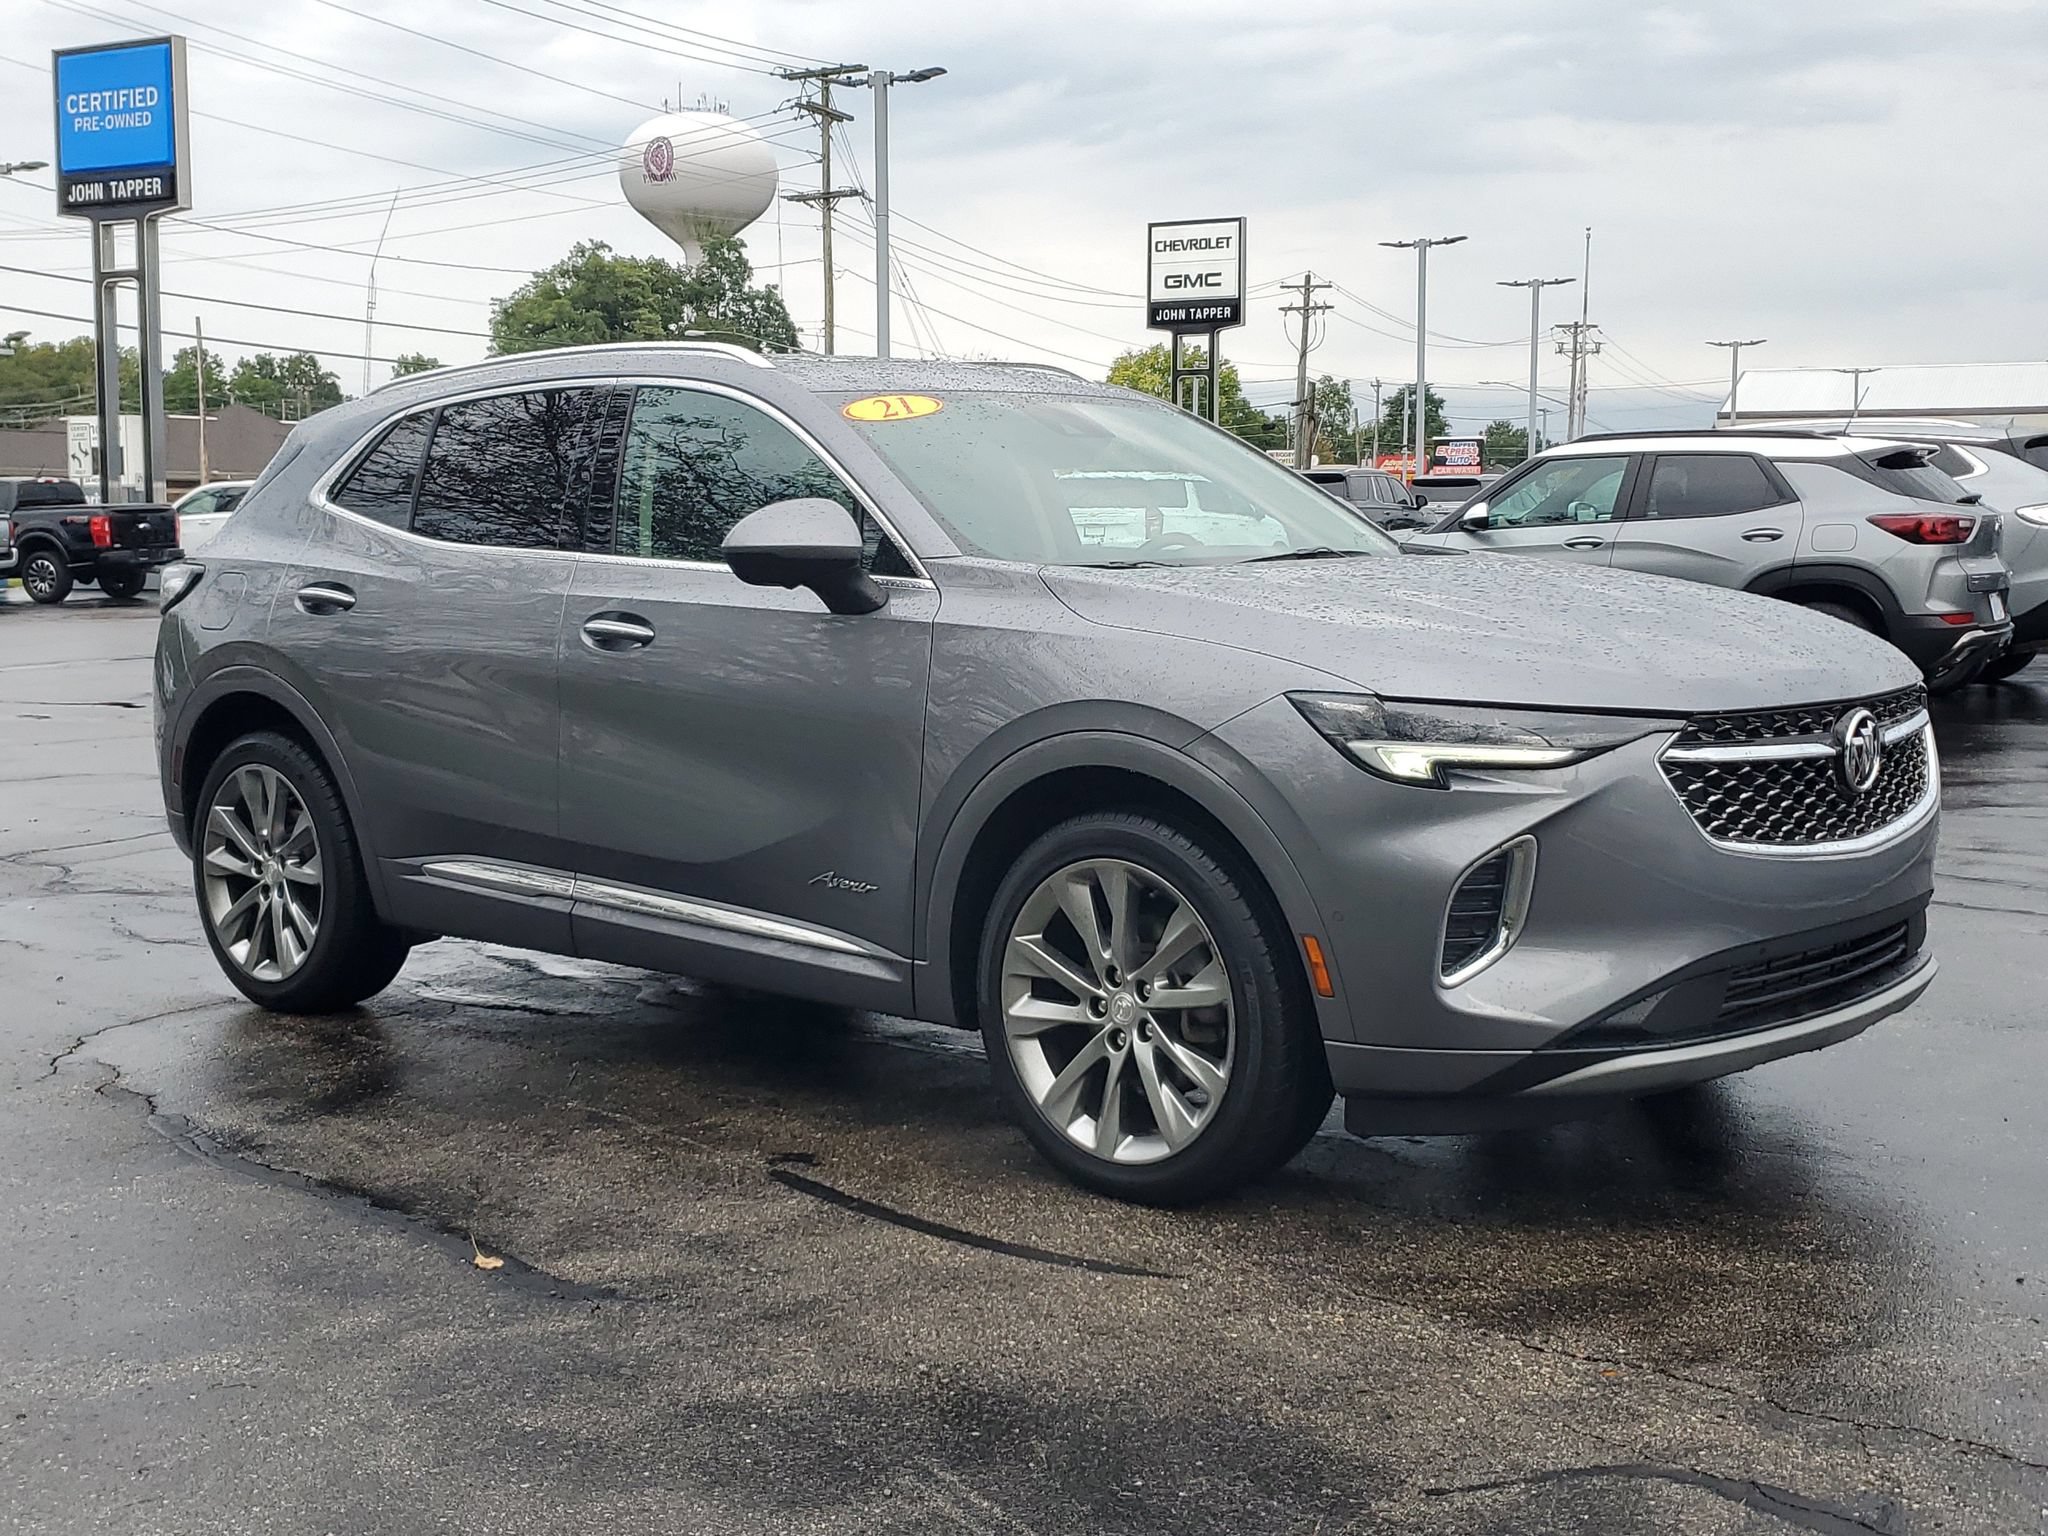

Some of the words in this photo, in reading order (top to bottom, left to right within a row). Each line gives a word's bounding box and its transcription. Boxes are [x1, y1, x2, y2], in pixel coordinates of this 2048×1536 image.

[66, 86, 159, 114] CERTIFIED
[74, 111, 152, 133] PRE-OWNED
[68, 182, 104, 202] JOHN
[110, 177, 162, 198] TAPPER
[1154, 235, 1233, 253] CHEVROLET
[1164, 271, 1222, 290] GMC
[1156, 308, 1186, 321] JOHN
[1189, 306, 1231, 320] TAPPER
[872, 397, 915, 418] 21
[1436, 446, 1478, 457] EXPRESS
[1435, 466, 1453, 474] CAR
[1454, 466, 1479, 474] WASH
